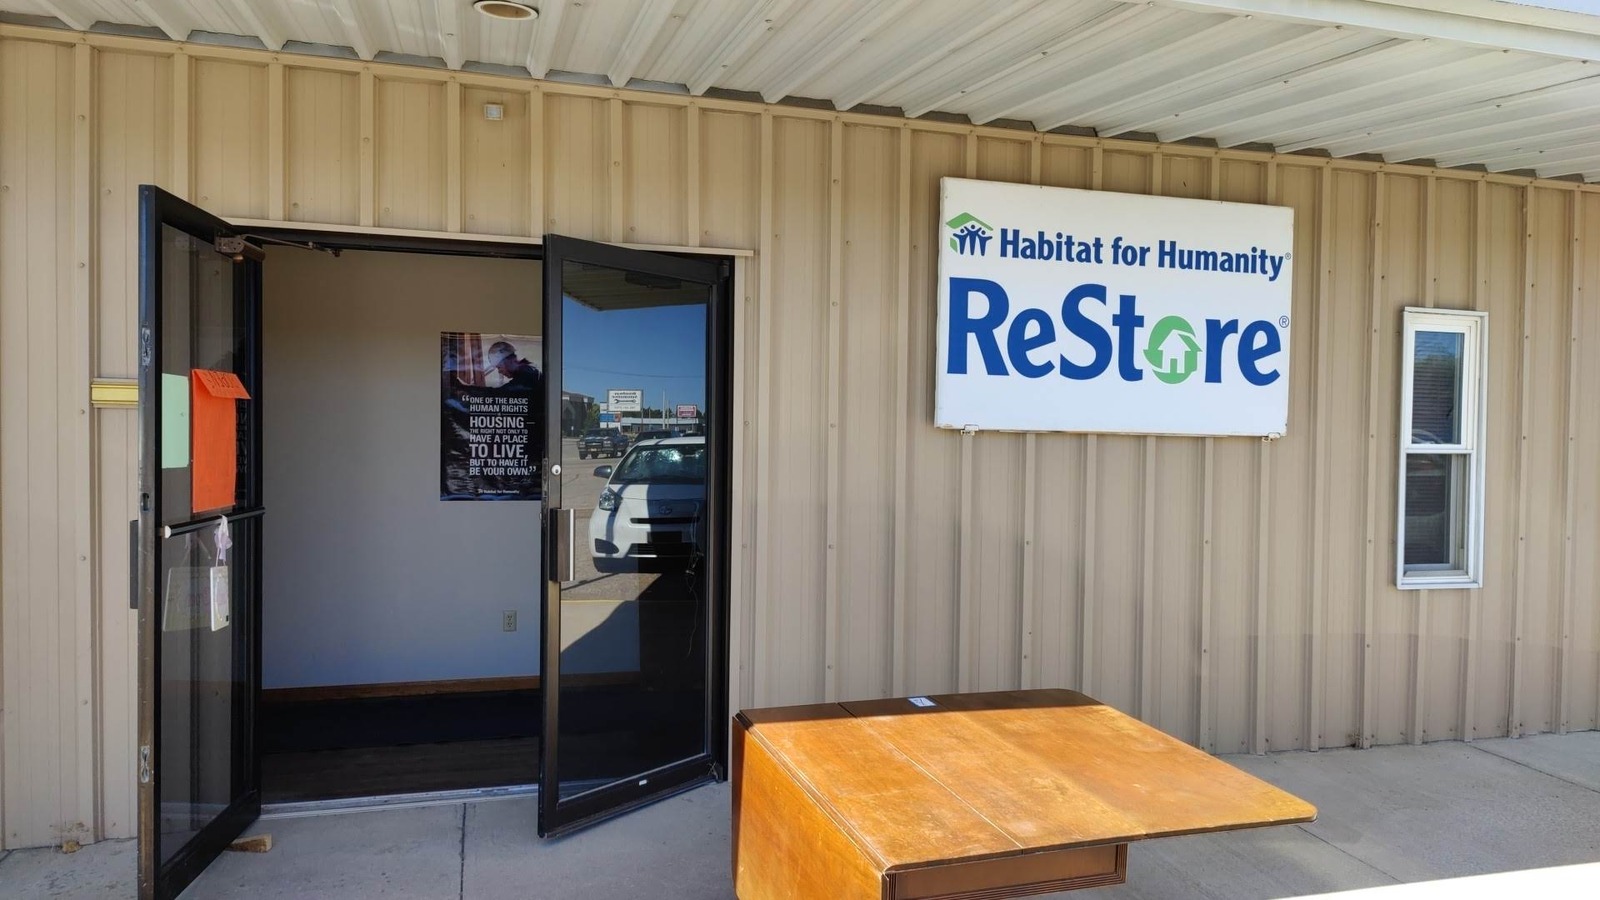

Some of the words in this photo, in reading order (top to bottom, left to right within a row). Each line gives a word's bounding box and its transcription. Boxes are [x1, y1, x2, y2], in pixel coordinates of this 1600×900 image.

[1000, 228, 1104, 265] Habitat
[1111, 236, 1151, 267] for
[470, 404, 500, 412] HUMAN
[501, 405, 529, 413] RIGHTS
[470, 434, 492, 443] HAVE
[494, 434, 501, 443] A
[502, 434, 529, 444] PLACE
[469, 443, 489, 458] TO
[493, 444, 529, 460] LIVE,
[470, 458, 486, 467] BUT
[486, 458, 497, 467] TO
[499, 459, 519, 467] HAVE
[520, 459, 528, 467] IT
[469, 467, 481, 476] BE
[482, 467, 505, 476] YOUR
